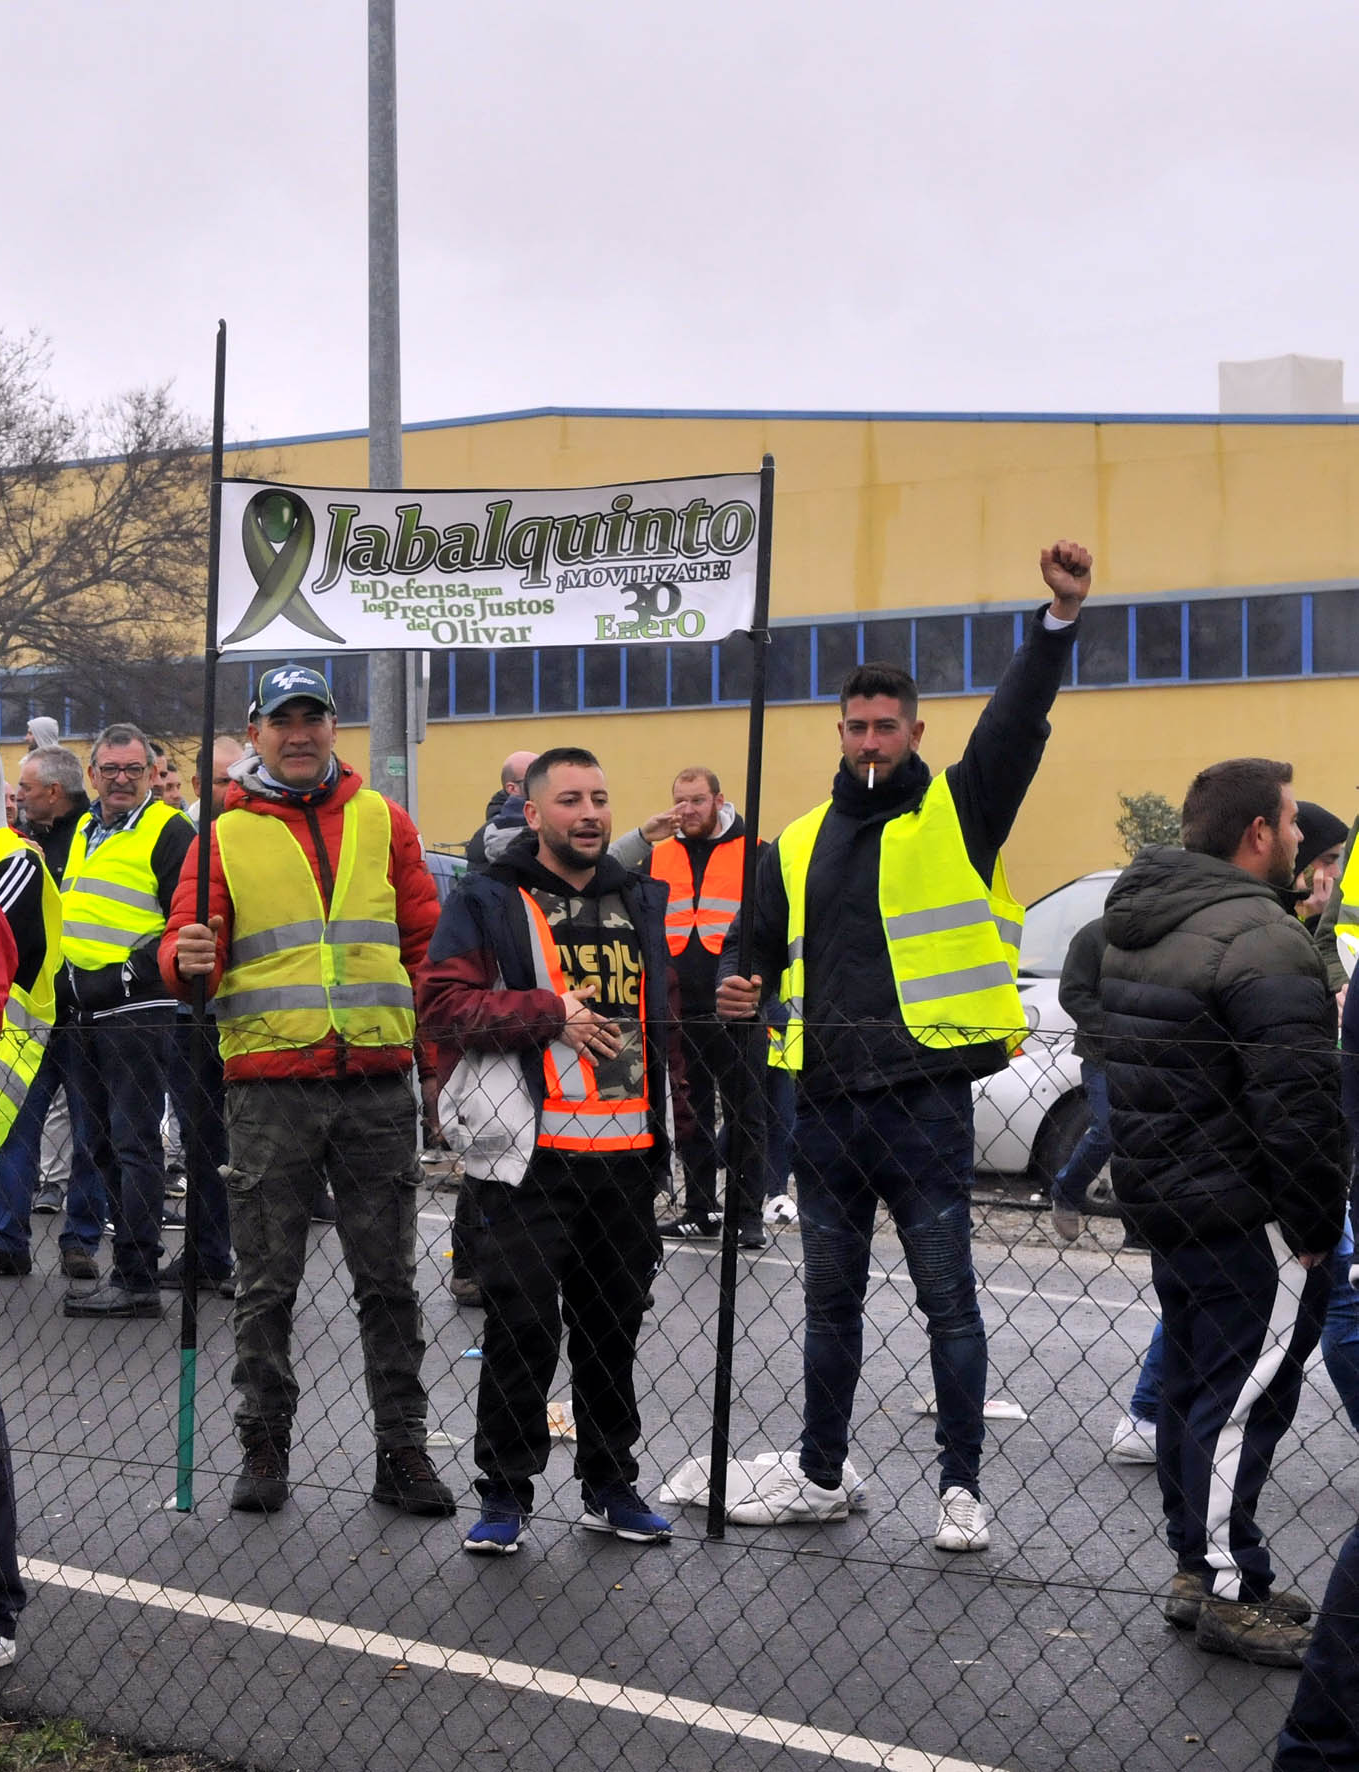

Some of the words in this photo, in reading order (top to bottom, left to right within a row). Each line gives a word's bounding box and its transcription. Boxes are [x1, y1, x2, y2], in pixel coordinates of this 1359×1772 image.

[311, 494, 756, 594] Jabalquinto
[369, 578, 473, 600] Defensa
[472, 586, 503, 599] para
[556, 560, 732, 593] ¡MOVILIZATE!
[362, 600, 385, 613] los
[384, 599, 476, 620] Precios
[478, 597, 555, 621] Justos
[619, 582, 682, 632] 30
[406, 619, 431, 631] del
[431, 620, 532, 644] Olivar
